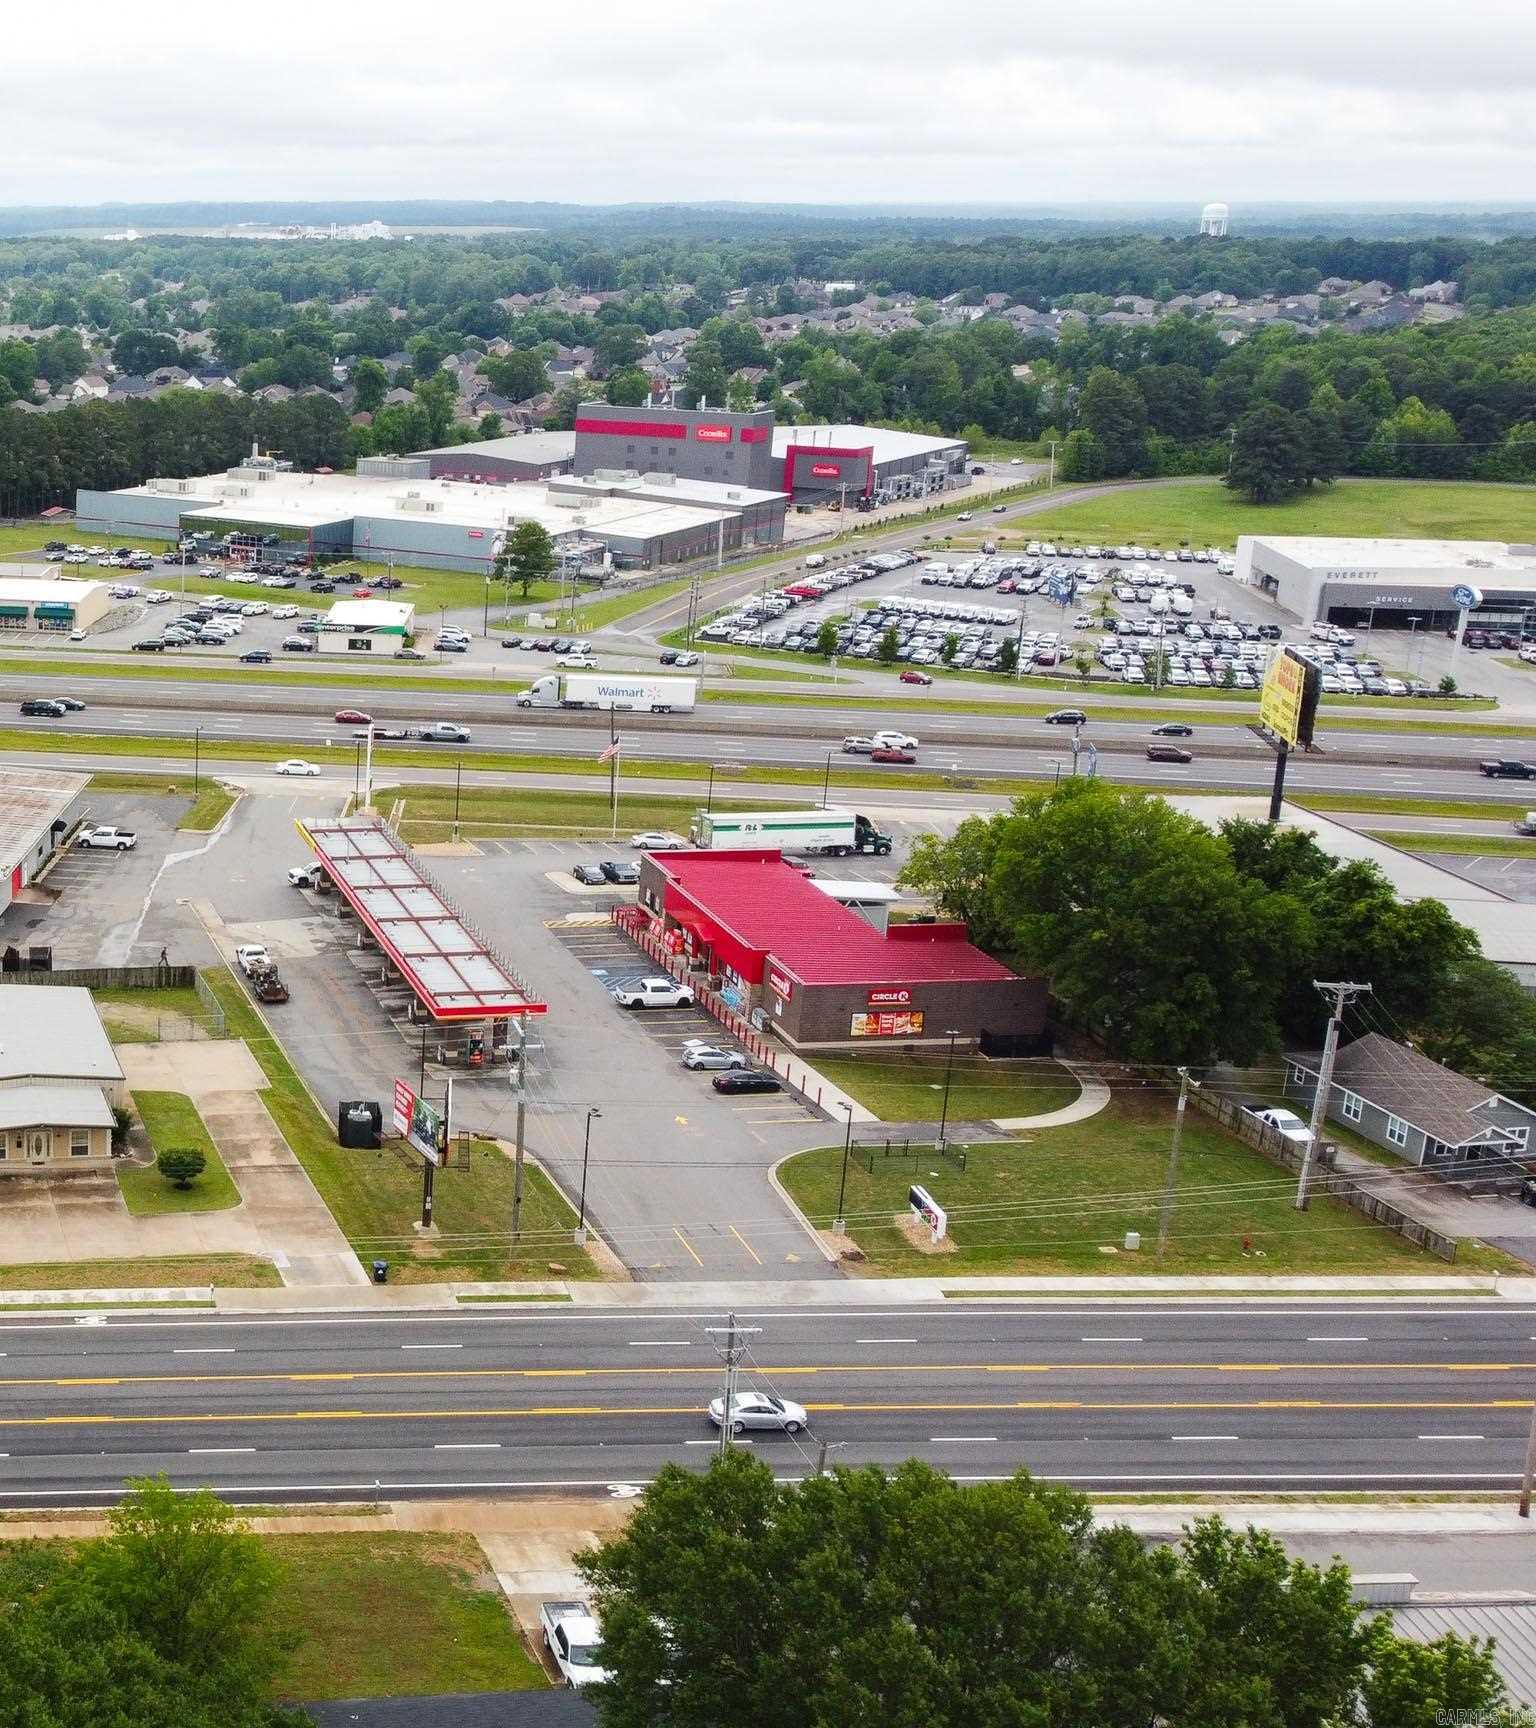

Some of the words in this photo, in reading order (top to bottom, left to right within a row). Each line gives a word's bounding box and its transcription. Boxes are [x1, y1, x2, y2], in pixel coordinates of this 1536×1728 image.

[1327, 571, 1379, 579] EVERETT
[598, 686, 645, 698] Walmart
[871, 993, 898, 1001] CIRCLE
